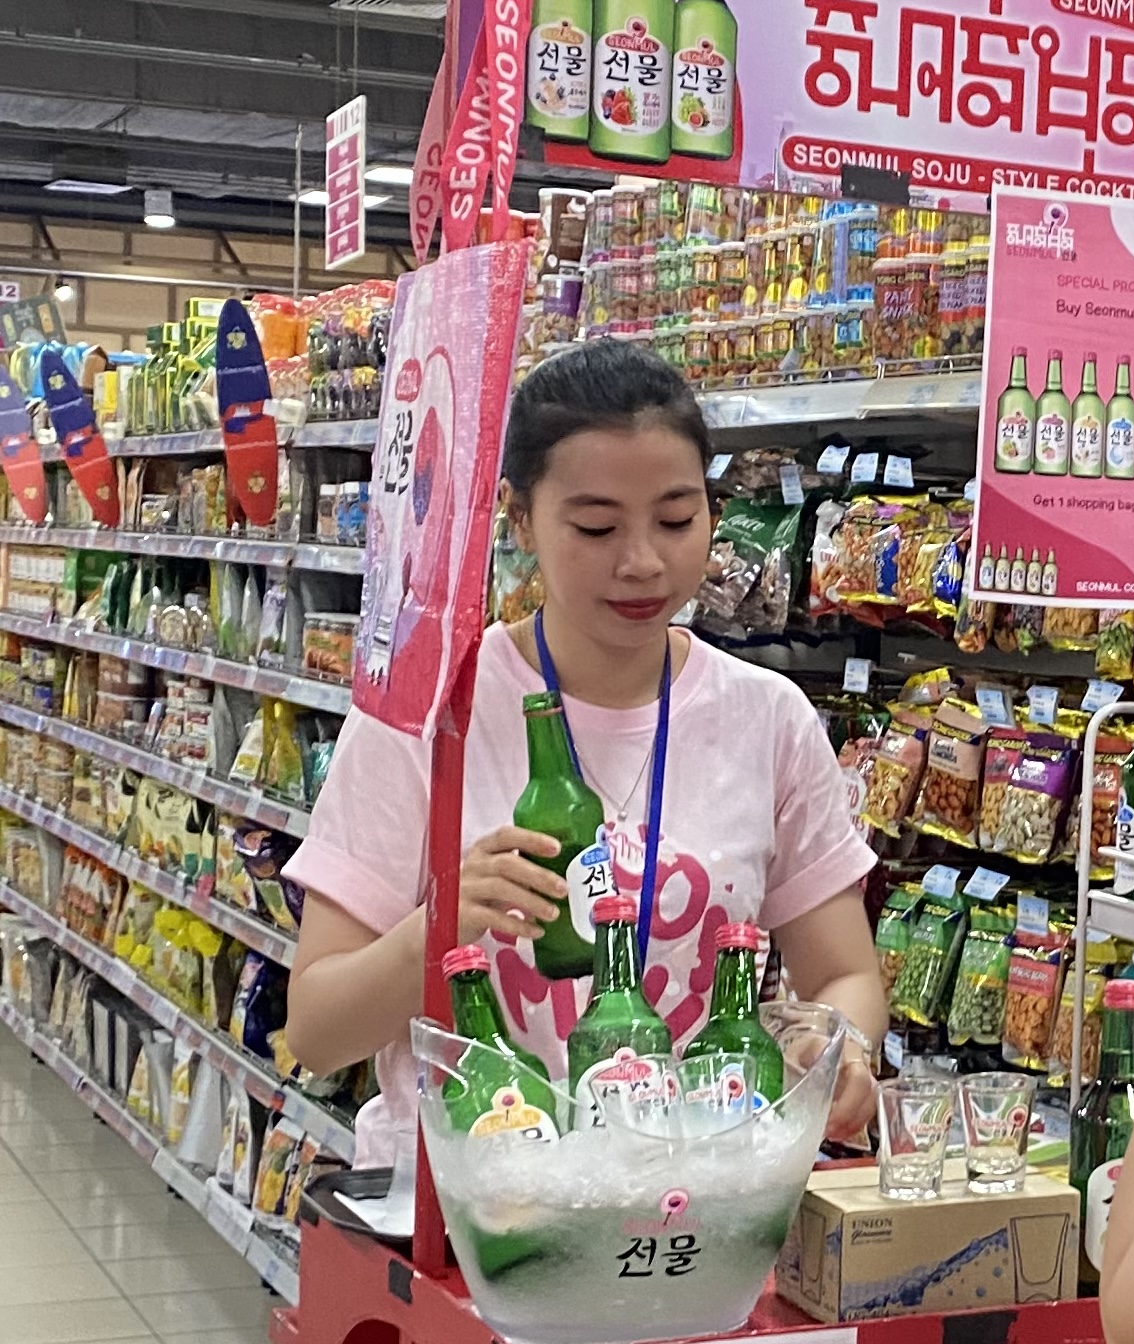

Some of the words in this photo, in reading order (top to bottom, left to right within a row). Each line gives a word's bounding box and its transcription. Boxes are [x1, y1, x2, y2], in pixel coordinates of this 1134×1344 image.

[602, 49, 663, 87] 선물
[677, 63, 727, 95] 선물
[911, 159, 970, 186] SOJU
[991, 167, 1060, 193] STYLE
[1056, 274, 1110, 292] SPECIAL
[1056, 299, 1081, 317] Buy
[1033, 493, 1055, 506] Get
[1067, 495, 1115, 512] shopping
[616, 1233, 702, 1278] 선물
